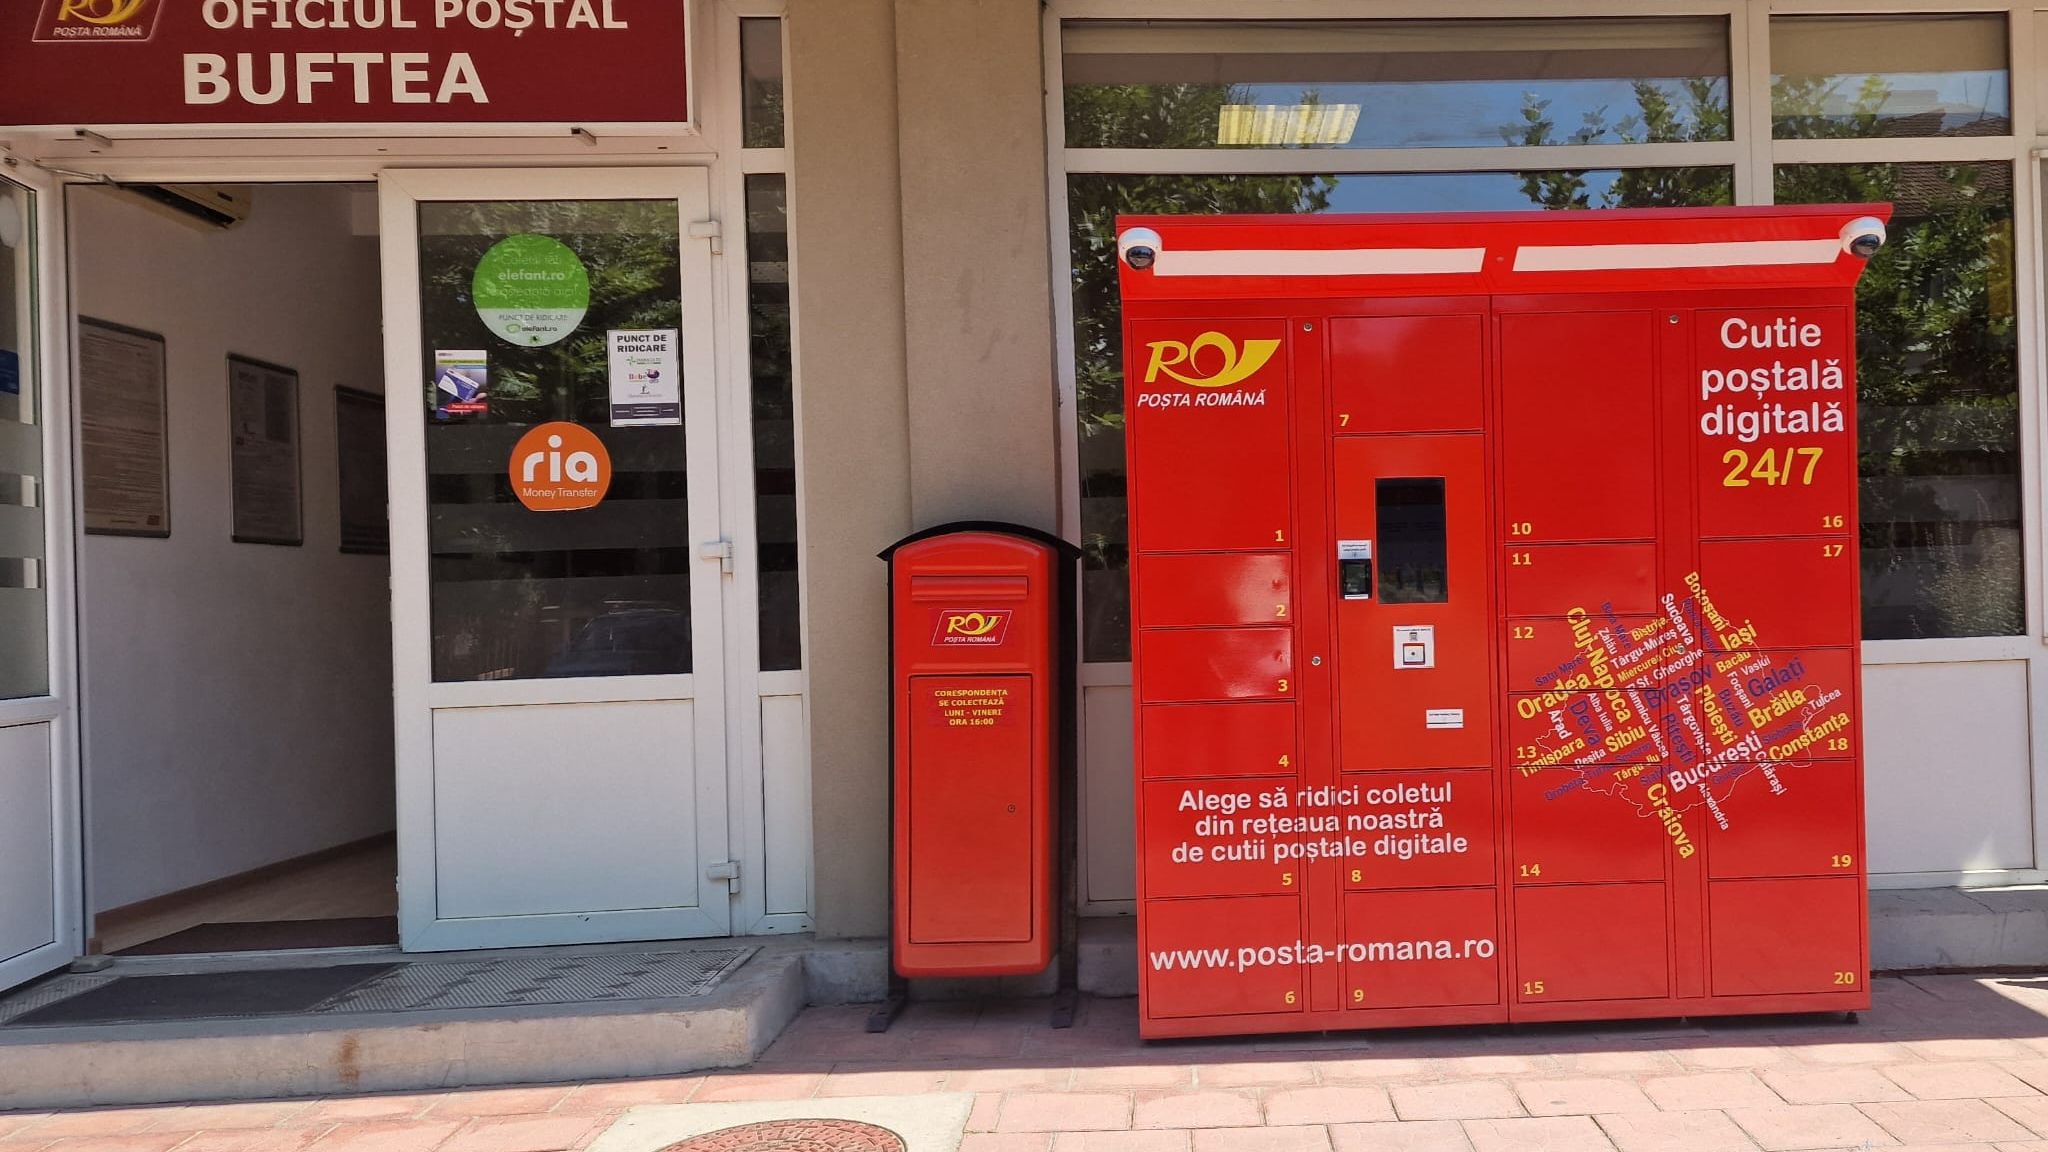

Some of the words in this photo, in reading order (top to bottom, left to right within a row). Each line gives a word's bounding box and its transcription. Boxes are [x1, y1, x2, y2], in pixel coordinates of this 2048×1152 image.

[202, 0, 417, 29] OFICIUL
[434, 0, 628, 37] POȘTAL
[183, 52, 489, 105] BUFTEA
[498, 269, 565, 281] elefant.ro
[522, 323, 558, 332] elefant.ro
[617, 335, 650, 343] PUNCT
[653, 334, 667, 342] DE
[1720, 316, 1822, 349] Cutie
[617, 344, 667, 353] RIDICARE
[1701, 358, 1843, 401] poștală
[1138, 393, 1191, 411] POȘTA
[1195, 388, 1267, 406] ROMÂNĂ
[1339, 413, 1350, 427] 7
[1700, 401, 1844, 442] digitală
[523, 434, 598, 482] ria
[1722, 447, 1823, 487] 24/7
[523, 487, 557, 500] Money
[557, 487, 597, 497] Transfer
[1511, 522, 1532, 535] 10
[1823, 515, 1843, 528] 16
[1275, 529, 1284, 542] 1
[1512, 552, 1532, 565] 11
[1823, 544, 1843, 557] 17
[1276, 604, 1286, 617] 2
[1661, 593, 1694, 646] Suceava
[1513, 626, 1535, 639] 12
[1598, 627, 1618, 655] Zalău
[1720, 619, 1757, 651] Iași
[1617, 654, 1663, 682] Miercurea
[1637, 675, 1653, 688] Sf.
[1653, 648, 1704, 680] Gheorghe
[1741, 655, 1771, 676] Vaslui
[1278, 679, 1288, 692] 3
[1517, 673, 1591, 719] Oradea
[1727, 671, 1754, 709] Focșani
[951, 697, 1005, 707] COLECTEAZĂ
[1748, 689, 1807, 729] Brăila
[1808, 688, 1842, 710] Tulcea
[1569, 700, 1601, 745] Deva
[1587, 692, 1603, 713] Alba
[1599, 711, 1613, 733] Iulia
[1695, 684, 1738, 745] Ploiești
[1548, 709, 1572, 739] Arad
[1605, 726, 1646, 752] Sibiu
[1769, 712, 1850, 760] Constanța
[1828, 738, 1848, 751] 18
[1278, 755, 1289, 768] 4
[1517, 746, 1536, 759] 13
[1668, 730, 1763, 793] București
[1178, 789, 1251, 815] Alege
[1259, 787, 1288, 808] să
[1297, 784, 1359, 807] ridici
[1366, 781, 1452, 806] coletul
[1195, 815, 1234, 837] din
[1242, 815, 1339, 839] rețeaua
[1347, 806, 1443, 832] noastră
[1647, 783, 1695, 859] Craiova
[1172, 842, 1204, 864] de
[1211, 839, 1266, 862] cutii
[1273, 834, 1367, 865] poștale
[1373, 832, 1468, 860] digitale
[1520, 863, 1541, 877] 14
[1831, 854, 1852, 868] 19
[1282, 872, 1293, 886] 5
[1351, 869, 1362, 883] 8
[1150, 938, 1495, 973] www.posta-romana.ro
[1523, 981, 1544, 995] 15
[1833, 971, 1854, 985] 20
[1285, 990, 1296, 1004] 6
[1354, 989, 1364, 1003] 9
